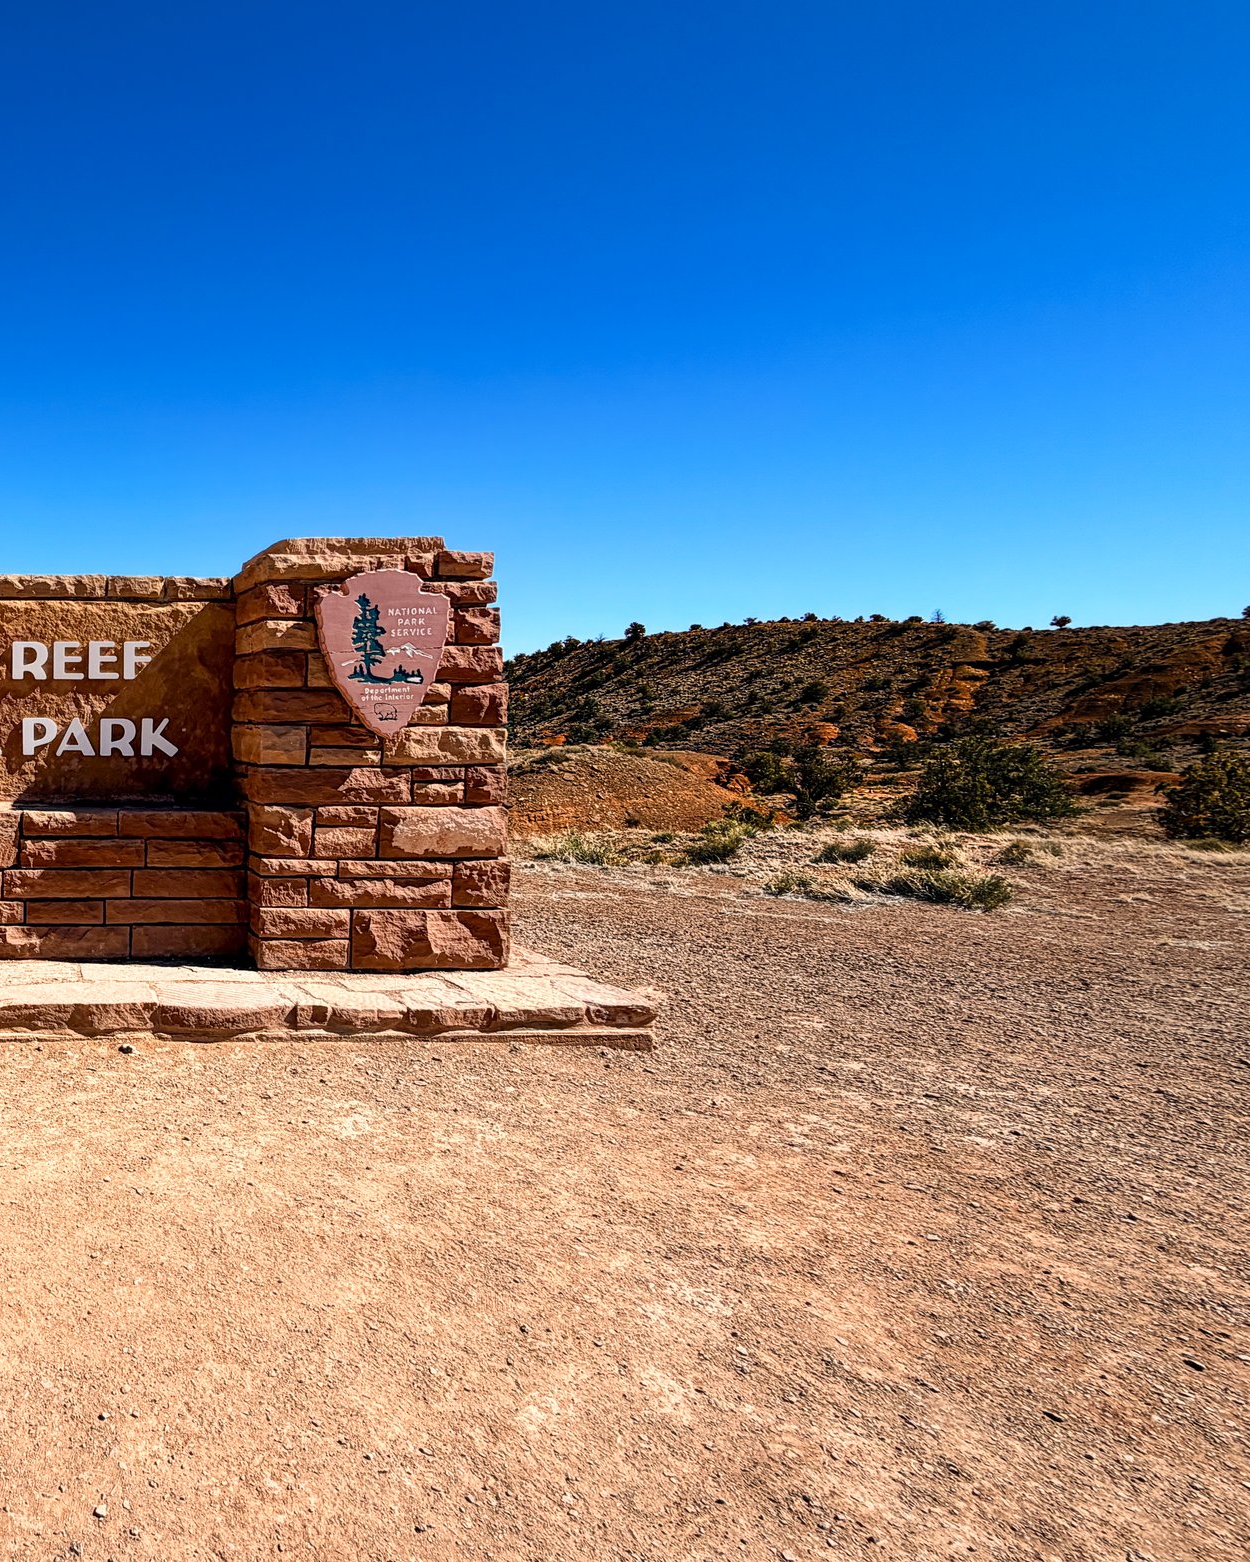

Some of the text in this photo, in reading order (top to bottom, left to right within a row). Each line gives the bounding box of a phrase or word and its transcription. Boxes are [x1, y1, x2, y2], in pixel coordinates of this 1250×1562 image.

[387, 606, 438, 616] NATIONAL
[397, 618, 426, 626] PARK
[390, 627, 433, 637] SERVICE
[11, 640, 153, 681] REEF
[364, 686, 411, 695] Department
[361, 694, 369, 702] of
[385, 693, 414, 701] Interior
[21, 716, 179, 757] PARK
